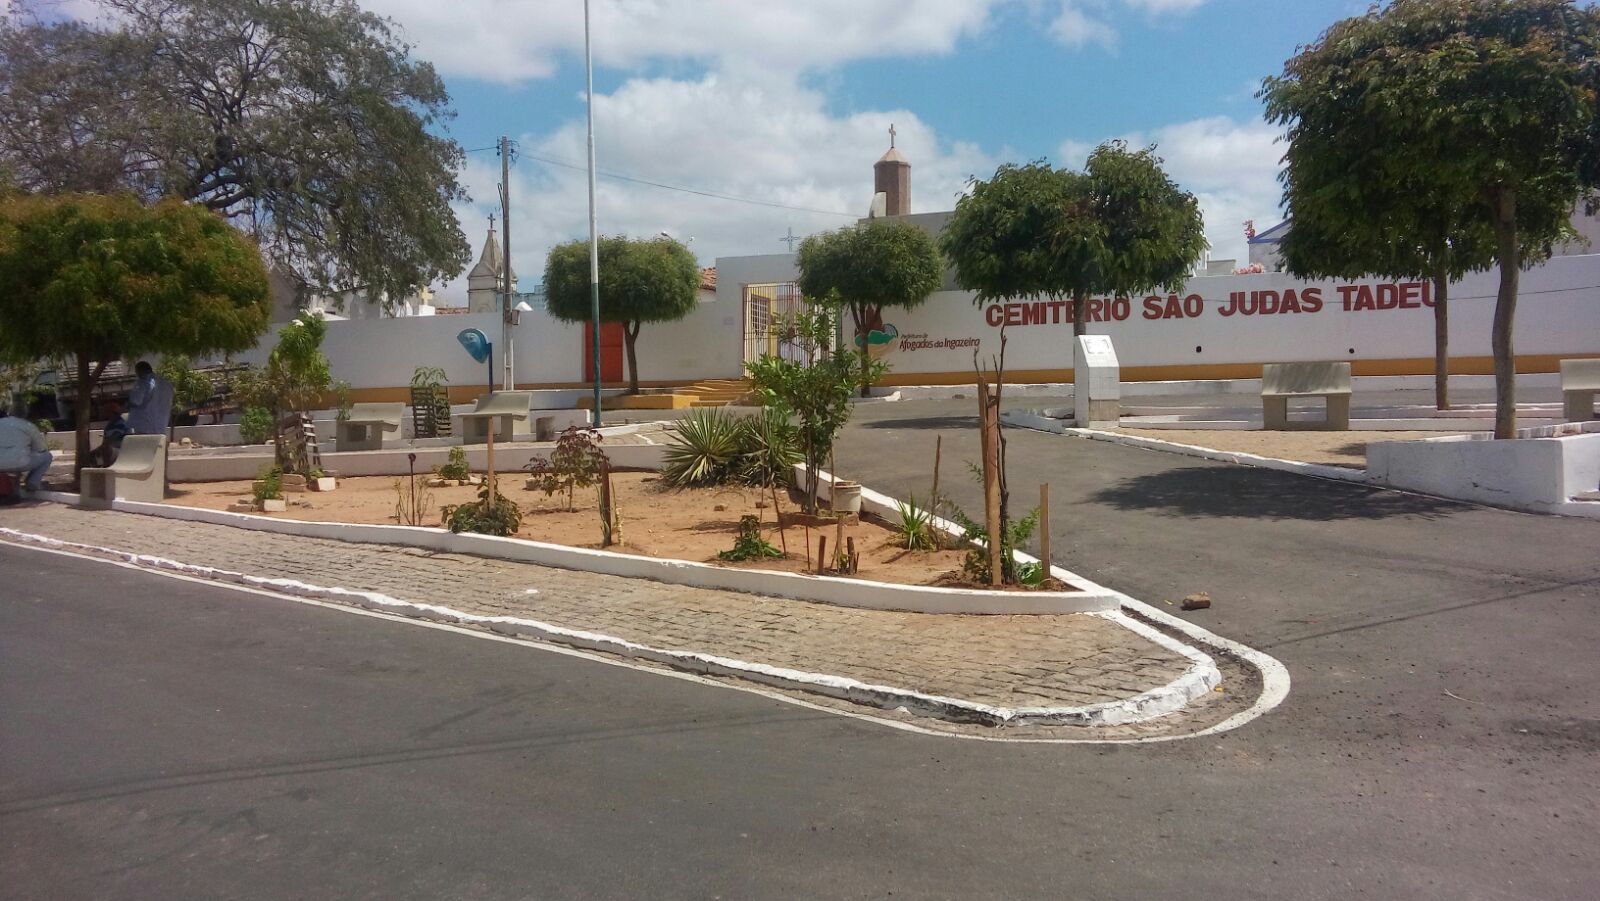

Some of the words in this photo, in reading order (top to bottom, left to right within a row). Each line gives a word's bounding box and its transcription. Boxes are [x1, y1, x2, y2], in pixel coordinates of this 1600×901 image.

[1142, 291, 1204, 320] SÃO
[1217, 287, 1324, 317] JUDAS
[899, 339, 934, 352] Afogados
